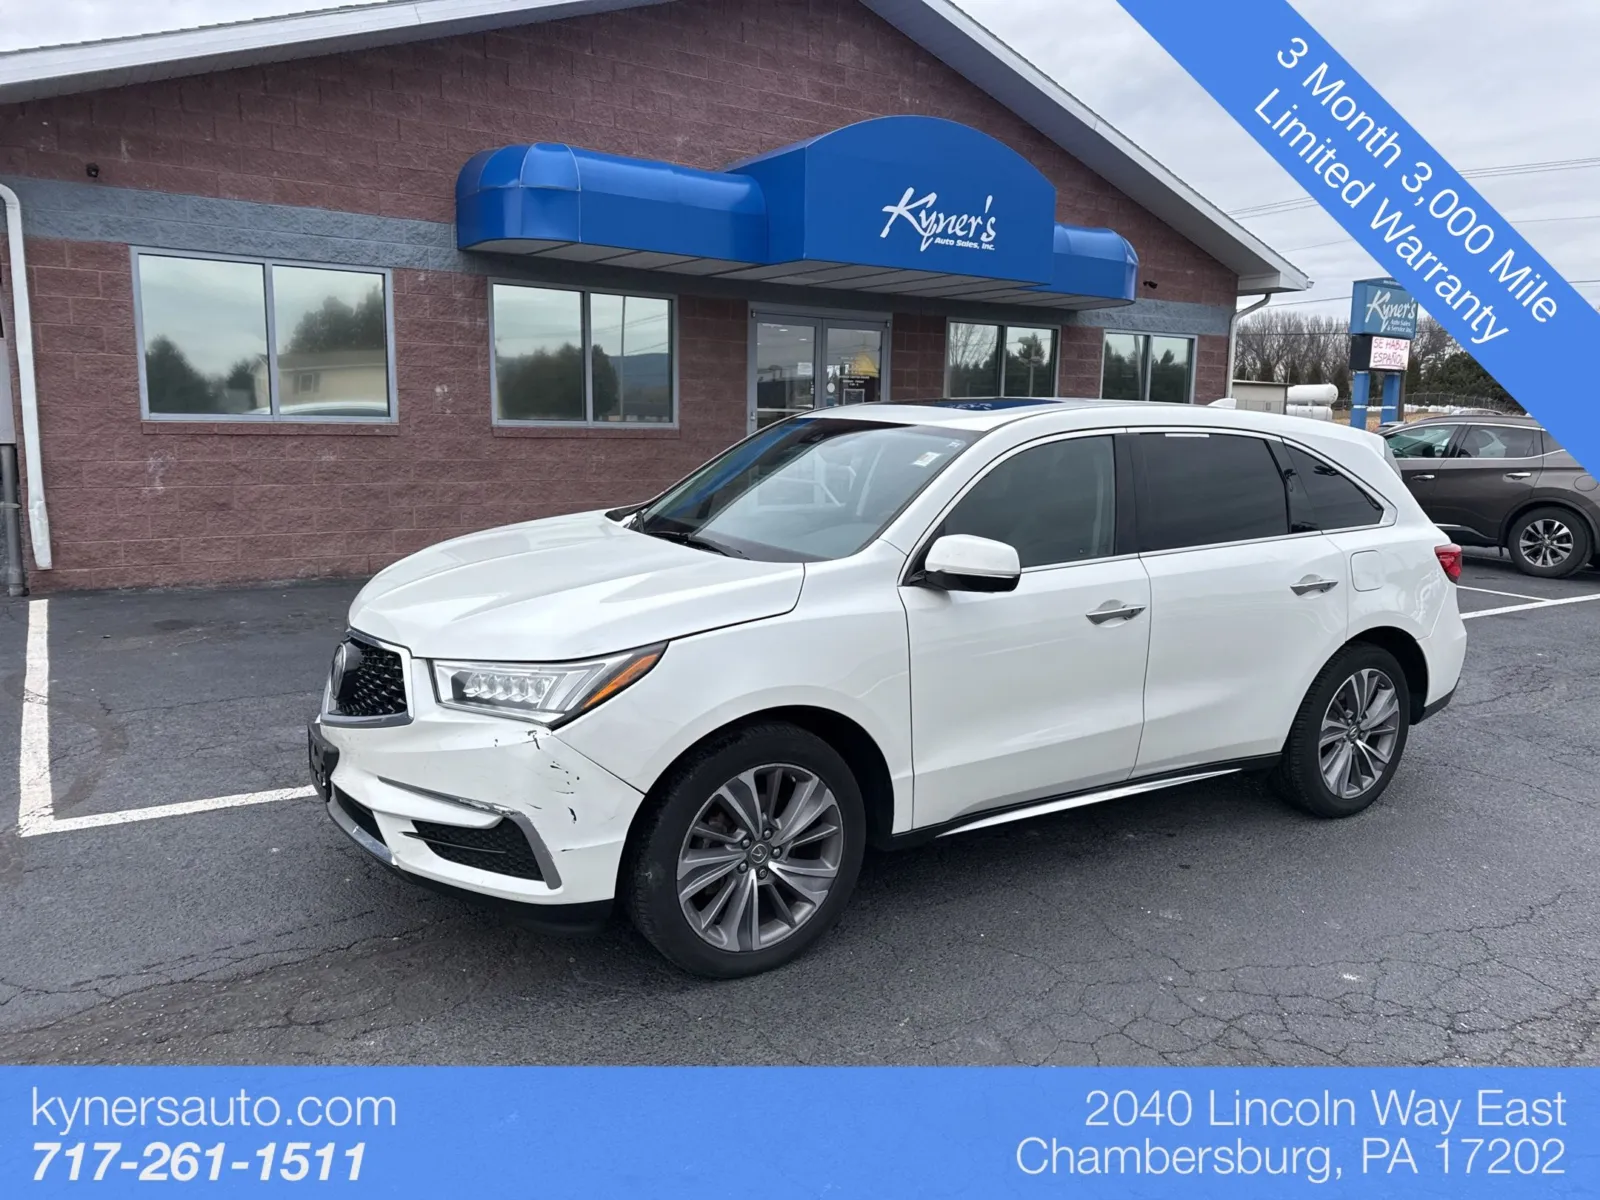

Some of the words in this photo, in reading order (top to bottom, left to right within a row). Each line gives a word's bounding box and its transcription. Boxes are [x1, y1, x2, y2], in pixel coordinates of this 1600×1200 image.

[880, 187, 996, 252] Kyner's
[934, 237, 954, 246] Auto
[956, 239, 979, 249] Sales,
[981, 242, 995, 251] Inc.
[1365, 290, 1416, 332] Kyner's
[1373, 338, 1385, 349] SE
[1385, 339, 1409, 351] HABLA
[1372, 352, 1405, 365] ESPAÑOL
